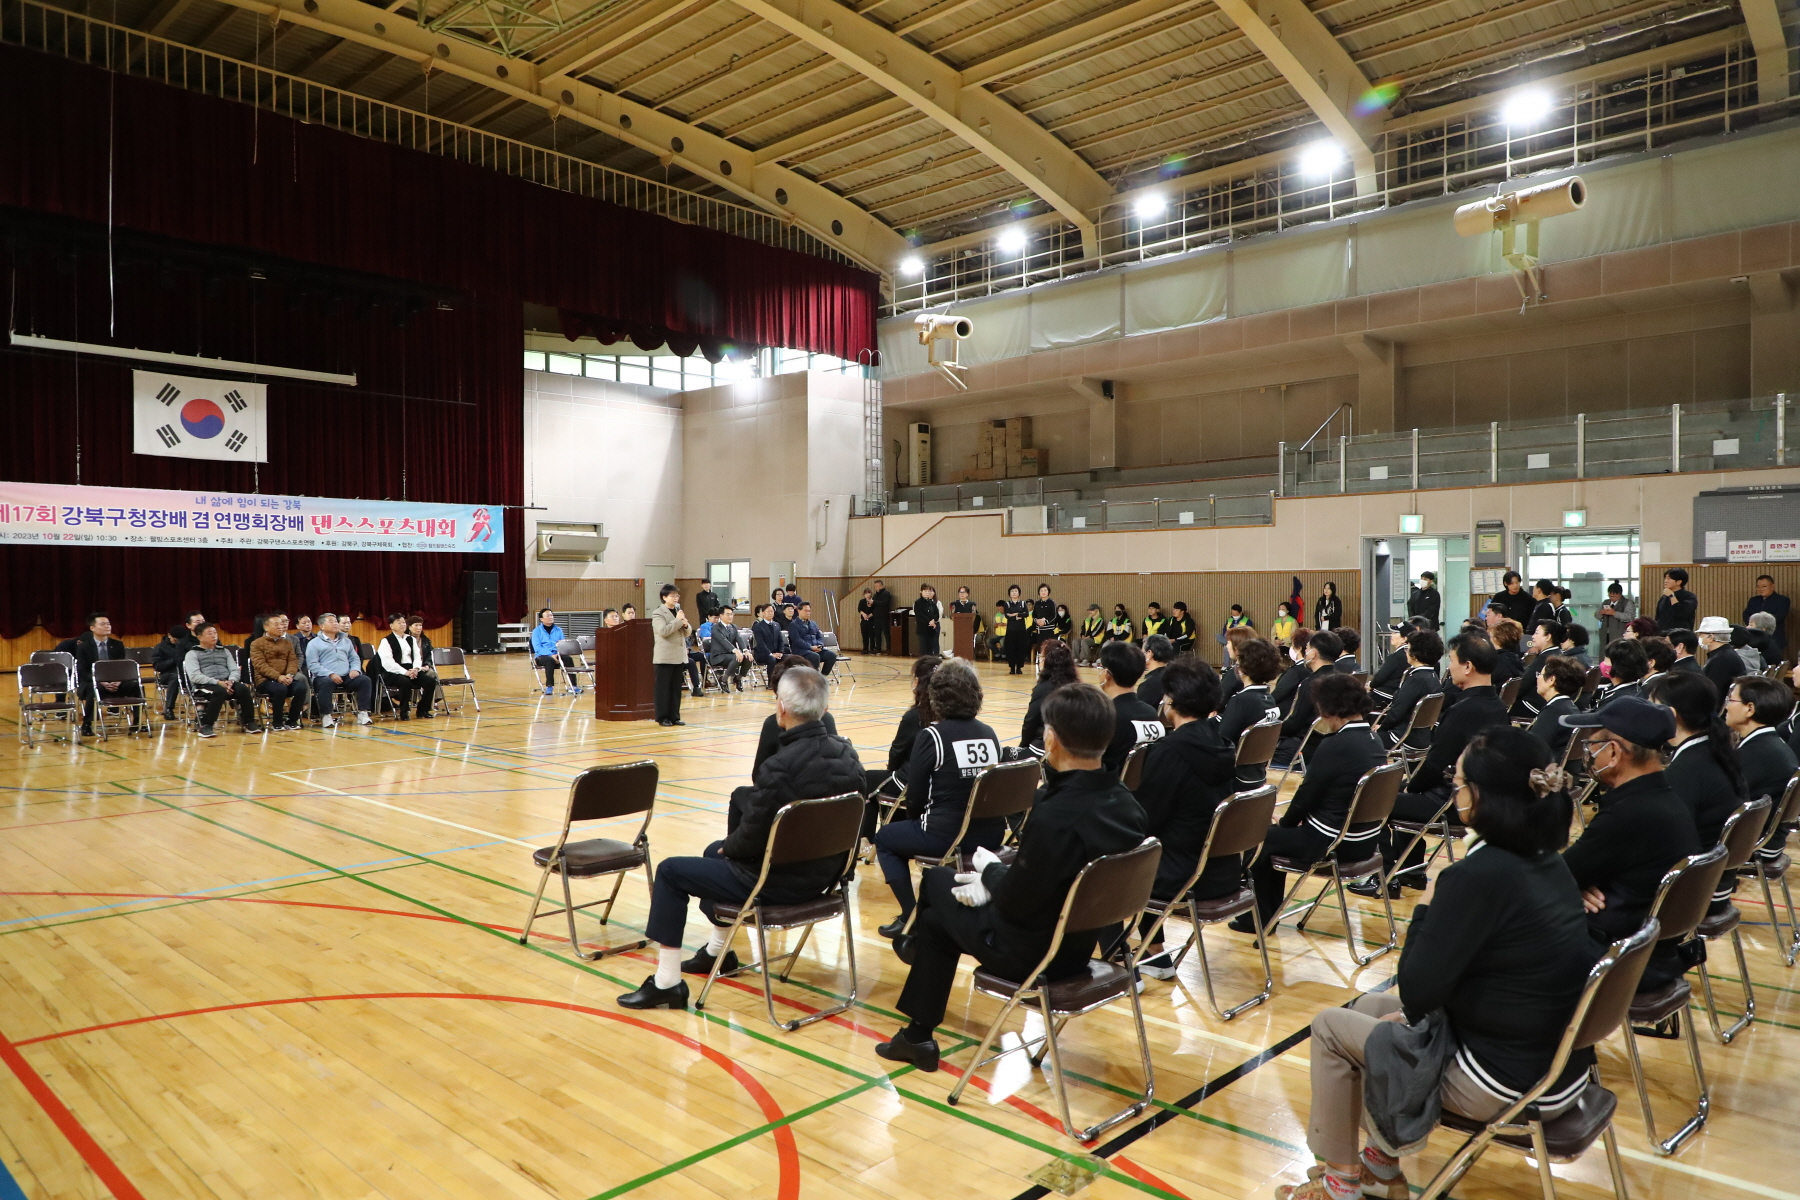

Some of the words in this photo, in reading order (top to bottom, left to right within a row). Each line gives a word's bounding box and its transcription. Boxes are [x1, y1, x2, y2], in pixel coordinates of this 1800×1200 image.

[195, 496, 206, 505] 내
[210, 496, 233, 508] 삶에
[237, 497, 257, 508] 힘이
[260, 498, 280, 510] 되는
[283, 499, 301, 511] 강북
[61, 506, 187, 529] 강북구청장배
[191, 511, 210, 530] 겸
[213, 512, 304, 532] 연맹회장배
[310, 514, 456, 538] 댄스스포츠대회
[12, 532, 39, 540] 2023년
[42, 532, 61, 541] 10월
[63, 533, 94, 541] 22일(일)
[130, 535, 147, 543] 장소:
[150, 536, 196, 544] 웰빙스포츠센터
[1142, 723, 1160, 741] 49
[966, 742, 990, 765] 53
